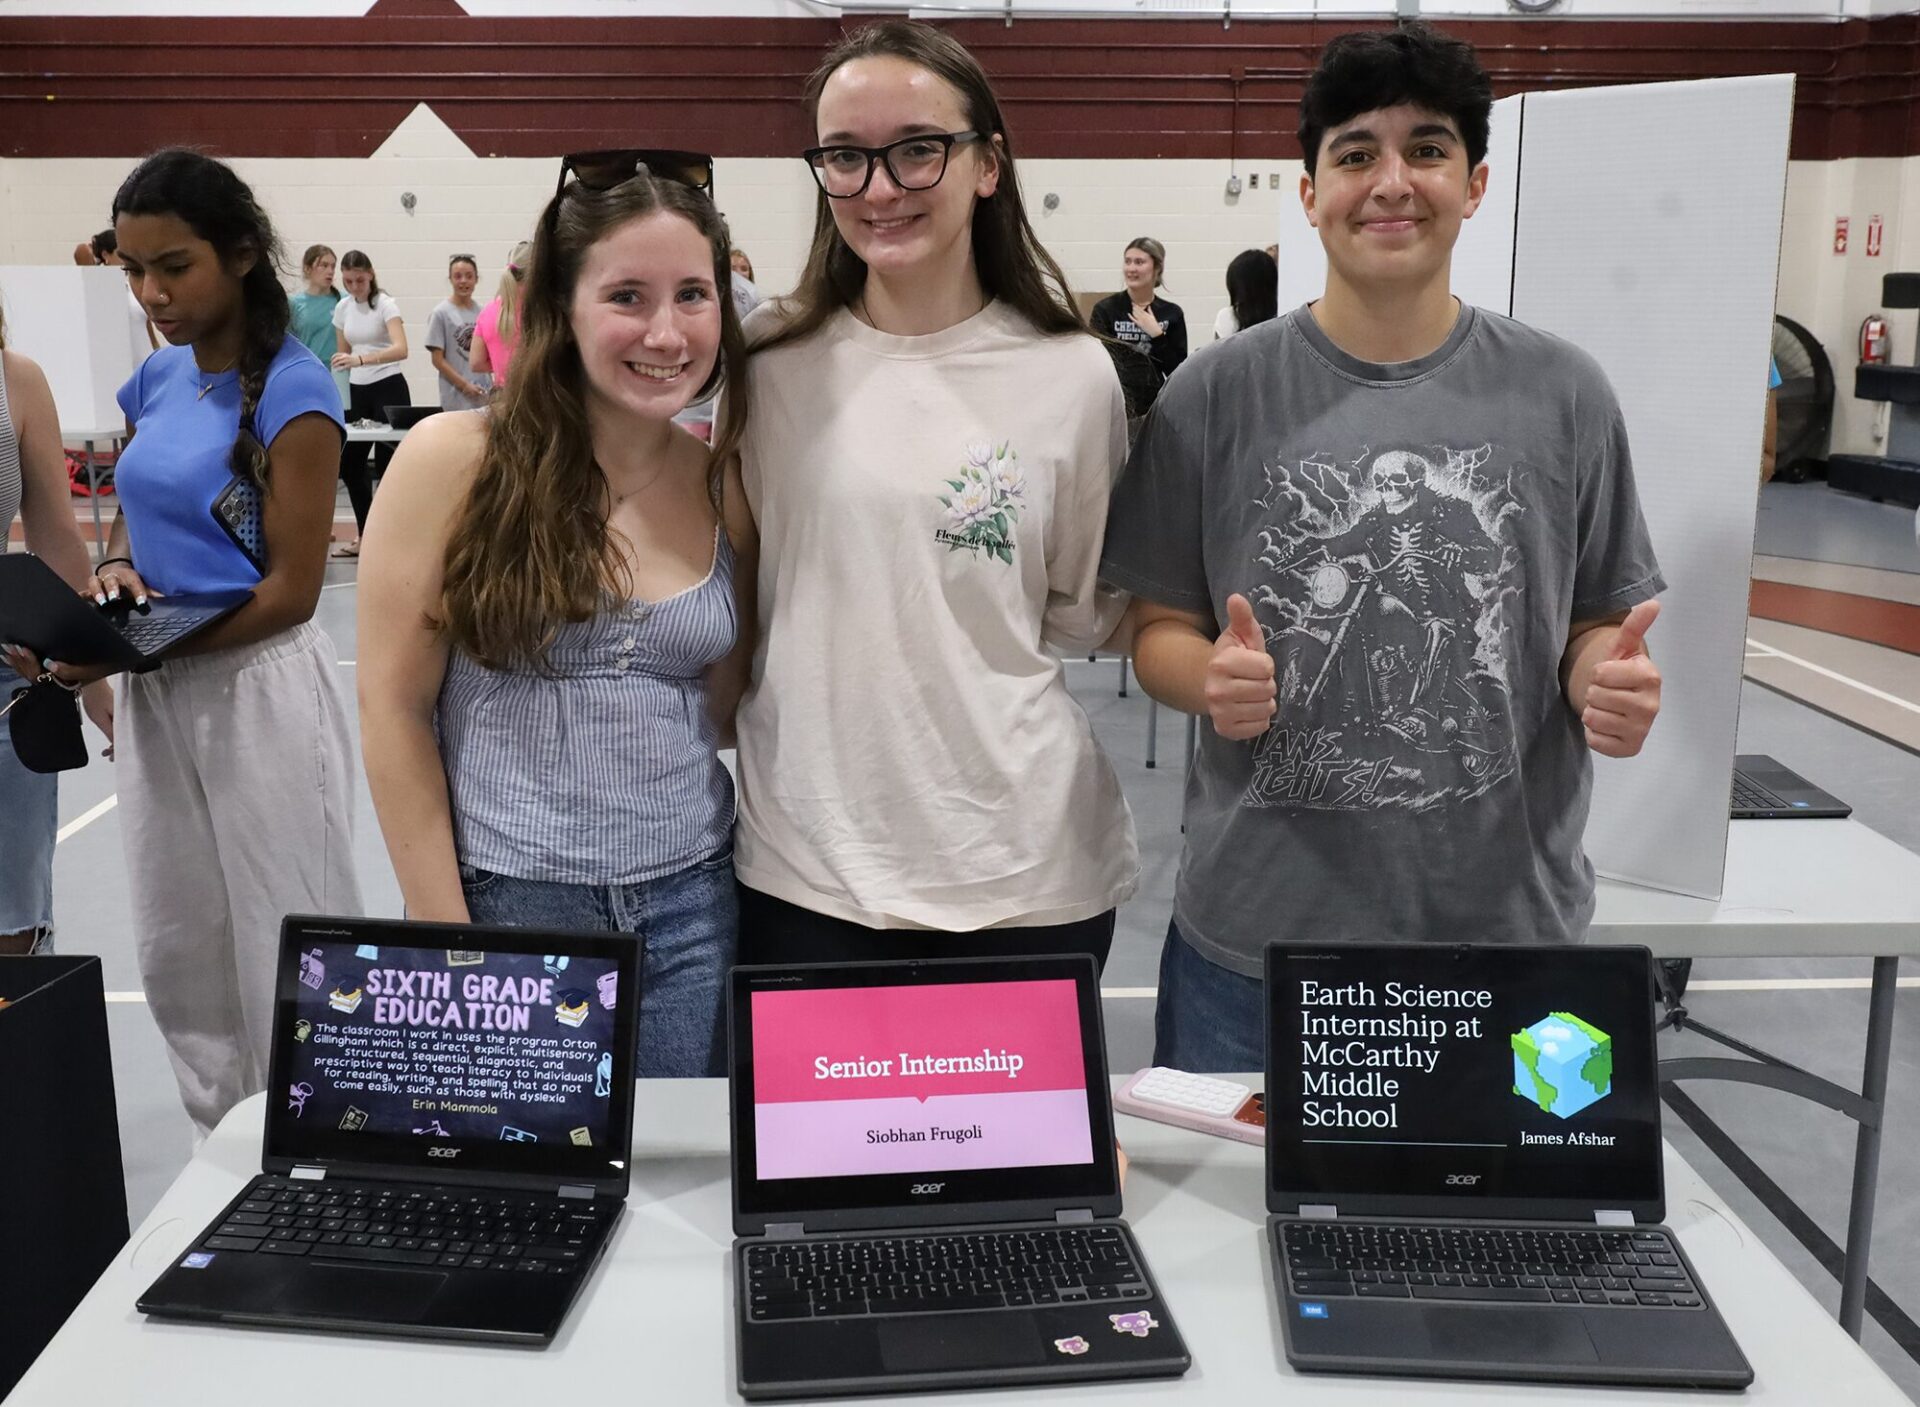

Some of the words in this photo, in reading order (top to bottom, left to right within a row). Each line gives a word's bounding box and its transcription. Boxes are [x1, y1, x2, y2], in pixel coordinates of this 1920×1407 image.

[936, 529, 967, 542] Fleurs
[366, 968, 451, 1000] SIXTH
[463, 974, 555, 1006] GRADE
[1301, 980, 1376, 1007] Earth
[1385, 982, 1493, 1009] Science
[374, 997, 531, 1033] EDUCATION
[1301, 1011, 1447, 1043] Internship
[1455, 1016, 1483, 1039] at
[314, 1034, 368, 1048] Gillingham
[372, 1038, 404, 1048] which
[408, 1040, 417, 1050] is
[421, 1042, 428, 1050] a
[432, 1042, 470, 1054] direct,
[474, 1044, 518, 1056] explicit,
[522, 1048, 597, 1062] multisensory,
[316, 1024, 338, 1034] The
[342, 1025, 399, 1037] classroom
[410, 1030, 438, 1040] work
[442, 1031, 452, 1040] in
[456, 1033, 481, 1042] uses
[486, 1034, 506, 1044] the
[509, 1038, 558, 1048] program
[562, 1038, 597, 1050] Orton
[344, 1048, 408, 1061] structured,
[412, 1052, 472, 1064] sequential,
[476, 1056, 538, 1068] diagnostic,
[542, 1060, 564, 1070] and
[814, 1055, 892, 1080] Senior
[899, 1048, 1024, 1079] Internship
[1302, 1041, 1441, 1072] McCarthy
[314, 1058, 382, 1069] prescriptive
[387, 1062, 410, 1072] way
[414, 1062, 428, 1072] to
[432, 1063, 464, 1074] teach
[468, 1066, 512, 1078] literacy
[516, 1069, 530, 1078] to
[534, 1070, 593, 1082] individuals
[324, 1068, 342, 1078] for
[346, 1070, 391, 1082] reading,
[396, 1072, 438, 1086] writing,
[442, 1076, 462, 1086] and
[468, 1078, 508, 1092] spelling
[512, 1080, 538, 1091] that
[542, 1082, 558, 1092] do
[562, 1084, 582, 1093] not
[333, 1080, 364, 1090] come
[368, 1082, 402, 1094] easily,
[406, 1084, 432, 1094] such
[436, 1088, 449, 1096] as
[454, 1087, 486, 1098] those
[491, 1088, 516, 1100] with
[520, 1092, 566, 1103] dyslexia
[1302, 1071, 1400, 1097] Middle
[412, 1100, 436, 1110] Erin
[440, 1101, 498, 1114] Mammola
[1302, 1102, 1398, 1129] School
[866, 1127, 926, 1144] Siobhan
[930, 1125, 983, 1144] Frugoli
[1520, 1131, 1564, 1146] James
[1567, 1131, 1616, 1147] Afshar
[427, 1146, 461, 1159] acer
[911, 1181, 945, 1195] acer
[1445, 1173, 1481, 1185] acer
